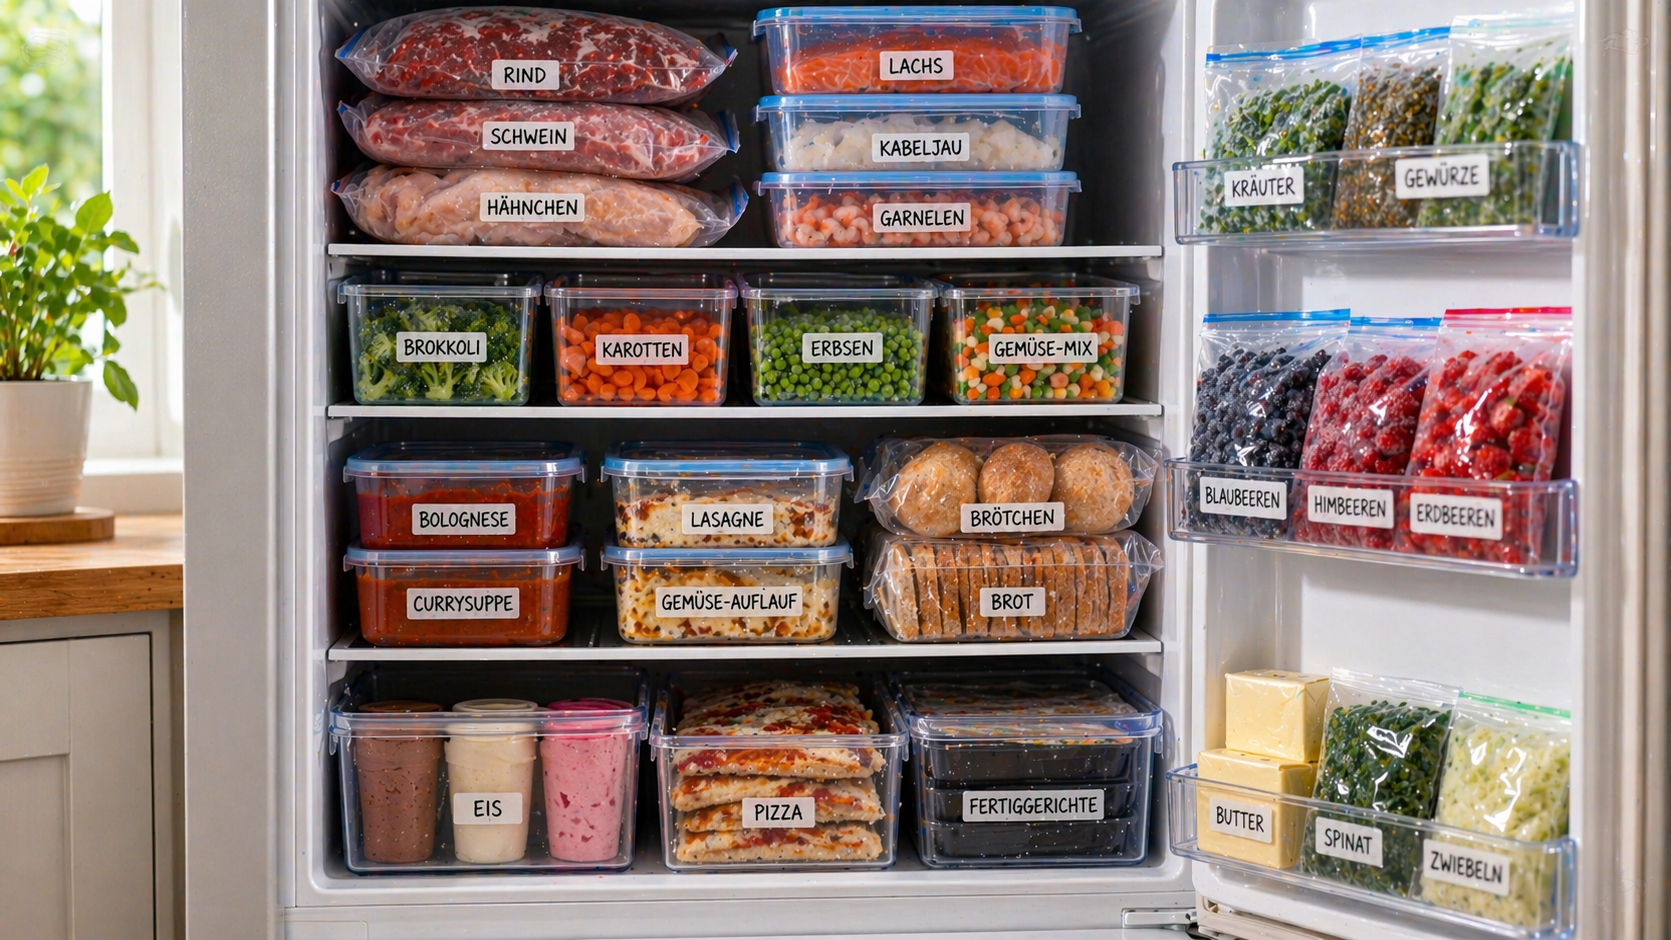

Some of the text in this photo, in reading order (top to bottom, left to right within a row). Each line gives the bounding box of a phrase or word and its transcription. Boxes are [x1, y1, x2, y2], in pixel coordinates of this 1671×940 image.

[503, 66, 547, 84] RIND
[889, 57, 944, 75] LACHS
[490, 127, 567, 145] SCHWEIN
[880, 139, 962, 157] KABELJAU
[1404, 162, 1480, 189] GEWÜRZE
[1231, 174, 1295, 198] KRÄUTER
[487, 195, 578, 216] HÄHNCHEN
[880, 209, 965, 227] GARNELEN
[403, 338, 480, 357] BROKKOLI
[602, 341, 682, 359] KAROTTEN
[811, 339, 874, 357] ERBSEN
[994, 336, 1093, 358] GEMÜSE-MIX
[1205, 486, 1280, 509] BLAUBEEREN
[1314, 495, 1386, 518] HIMBEEREN
[418, 510, 509, 529] BOLOGNESE
[691, 510, 764, 529] LASAGNE
[970, 506, 1055, 528] BRÖTCHEN
[1417, 503, 1494, 527] ERDBEEREN
[413, 594, 514, 613] CURRYSUPPE
[661, 590, 798, 611] GEMÜSE-AUFLAUF
[991, 593, 1034, 611] BROT
[473, 799, 503, 818] EIS
[754, 803, 803, 822] PIZZA
[969, 796, 1098, 816] FERTIGGERICHTE
[1216, 805, 1265, 833] BUTTER
[1324, 828, 1373, 855] SPINAT
[1430, 850, 1502, 883] ZWIEBELN
